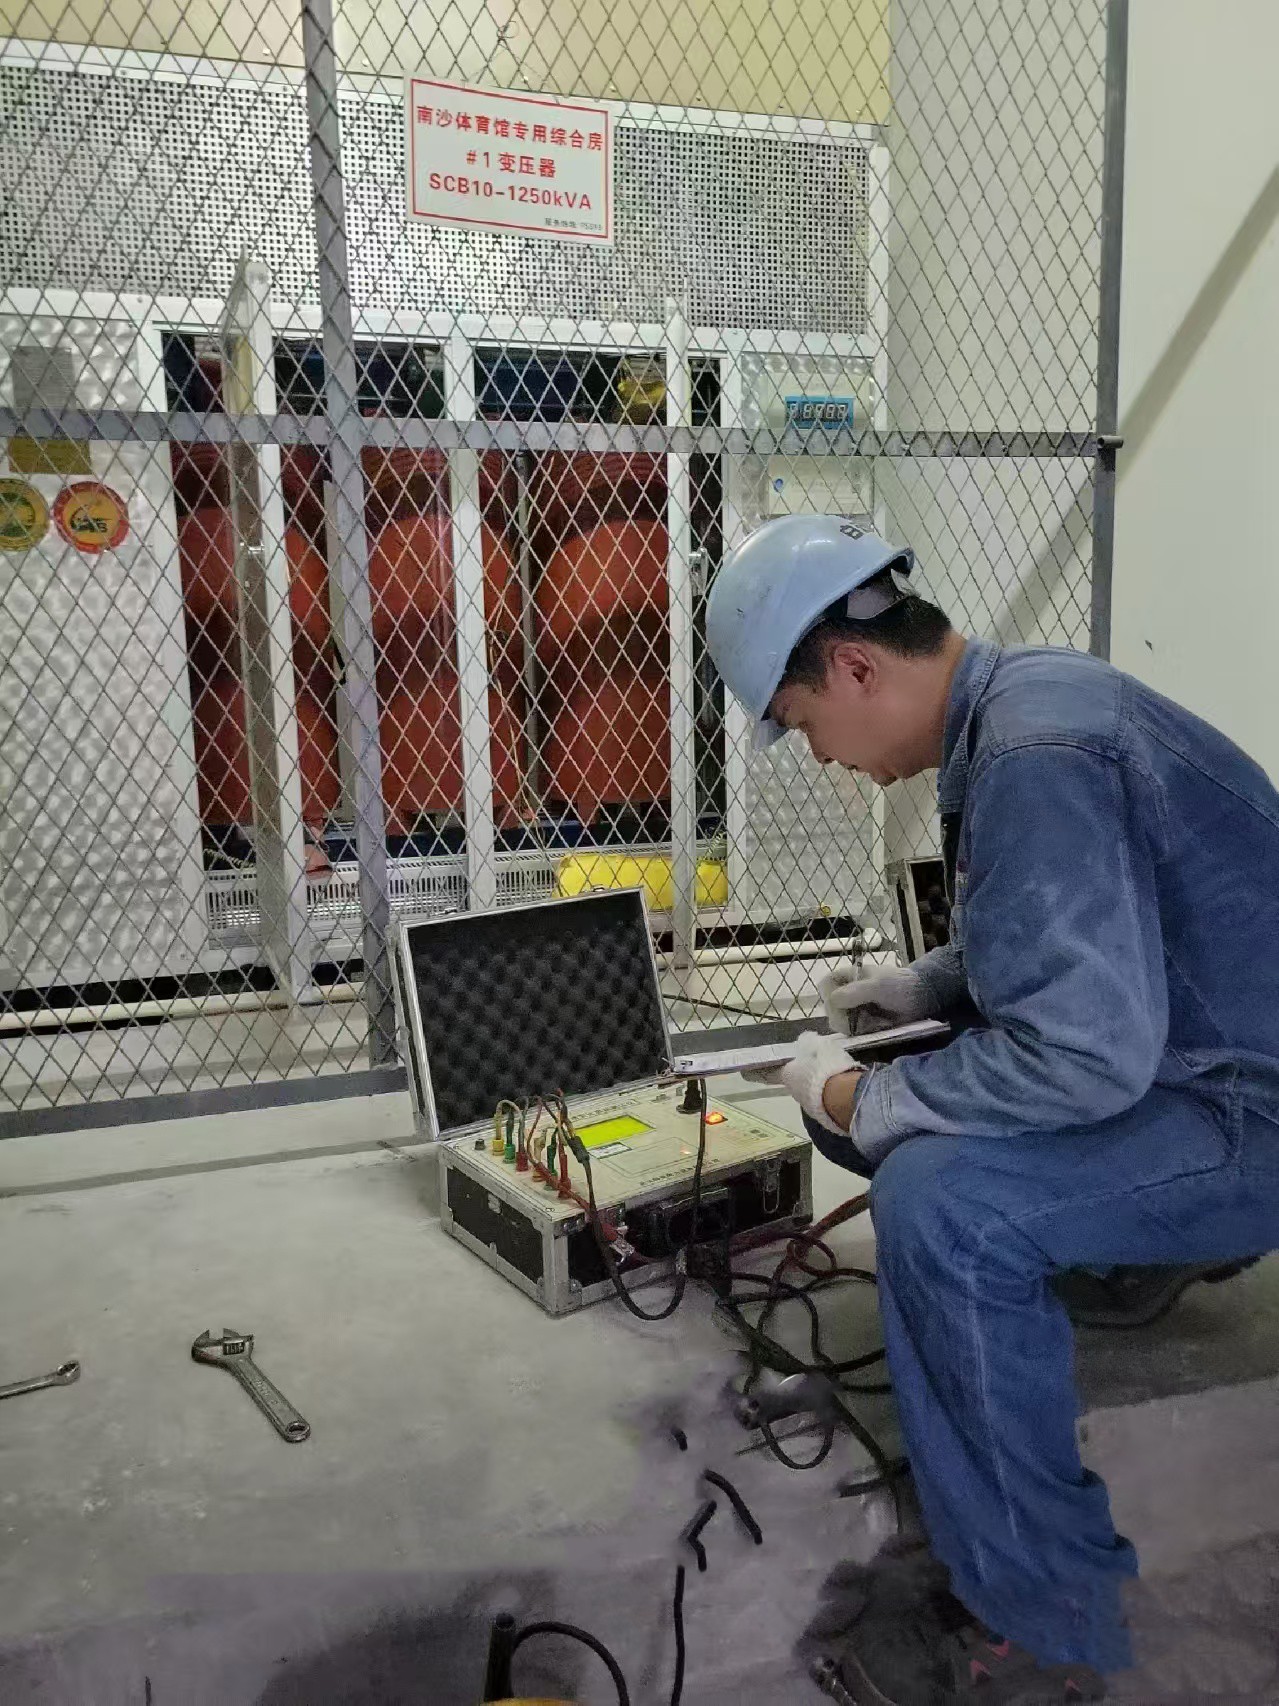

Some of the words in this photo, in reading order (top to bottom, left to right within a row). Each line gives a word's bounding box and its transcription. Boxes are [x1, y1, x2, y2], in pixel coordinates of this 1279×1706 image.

[417, 105, 603, 150] 南沙体育馆专用综合房
[430, 172, 592, 210] SCB10-1250kVA
